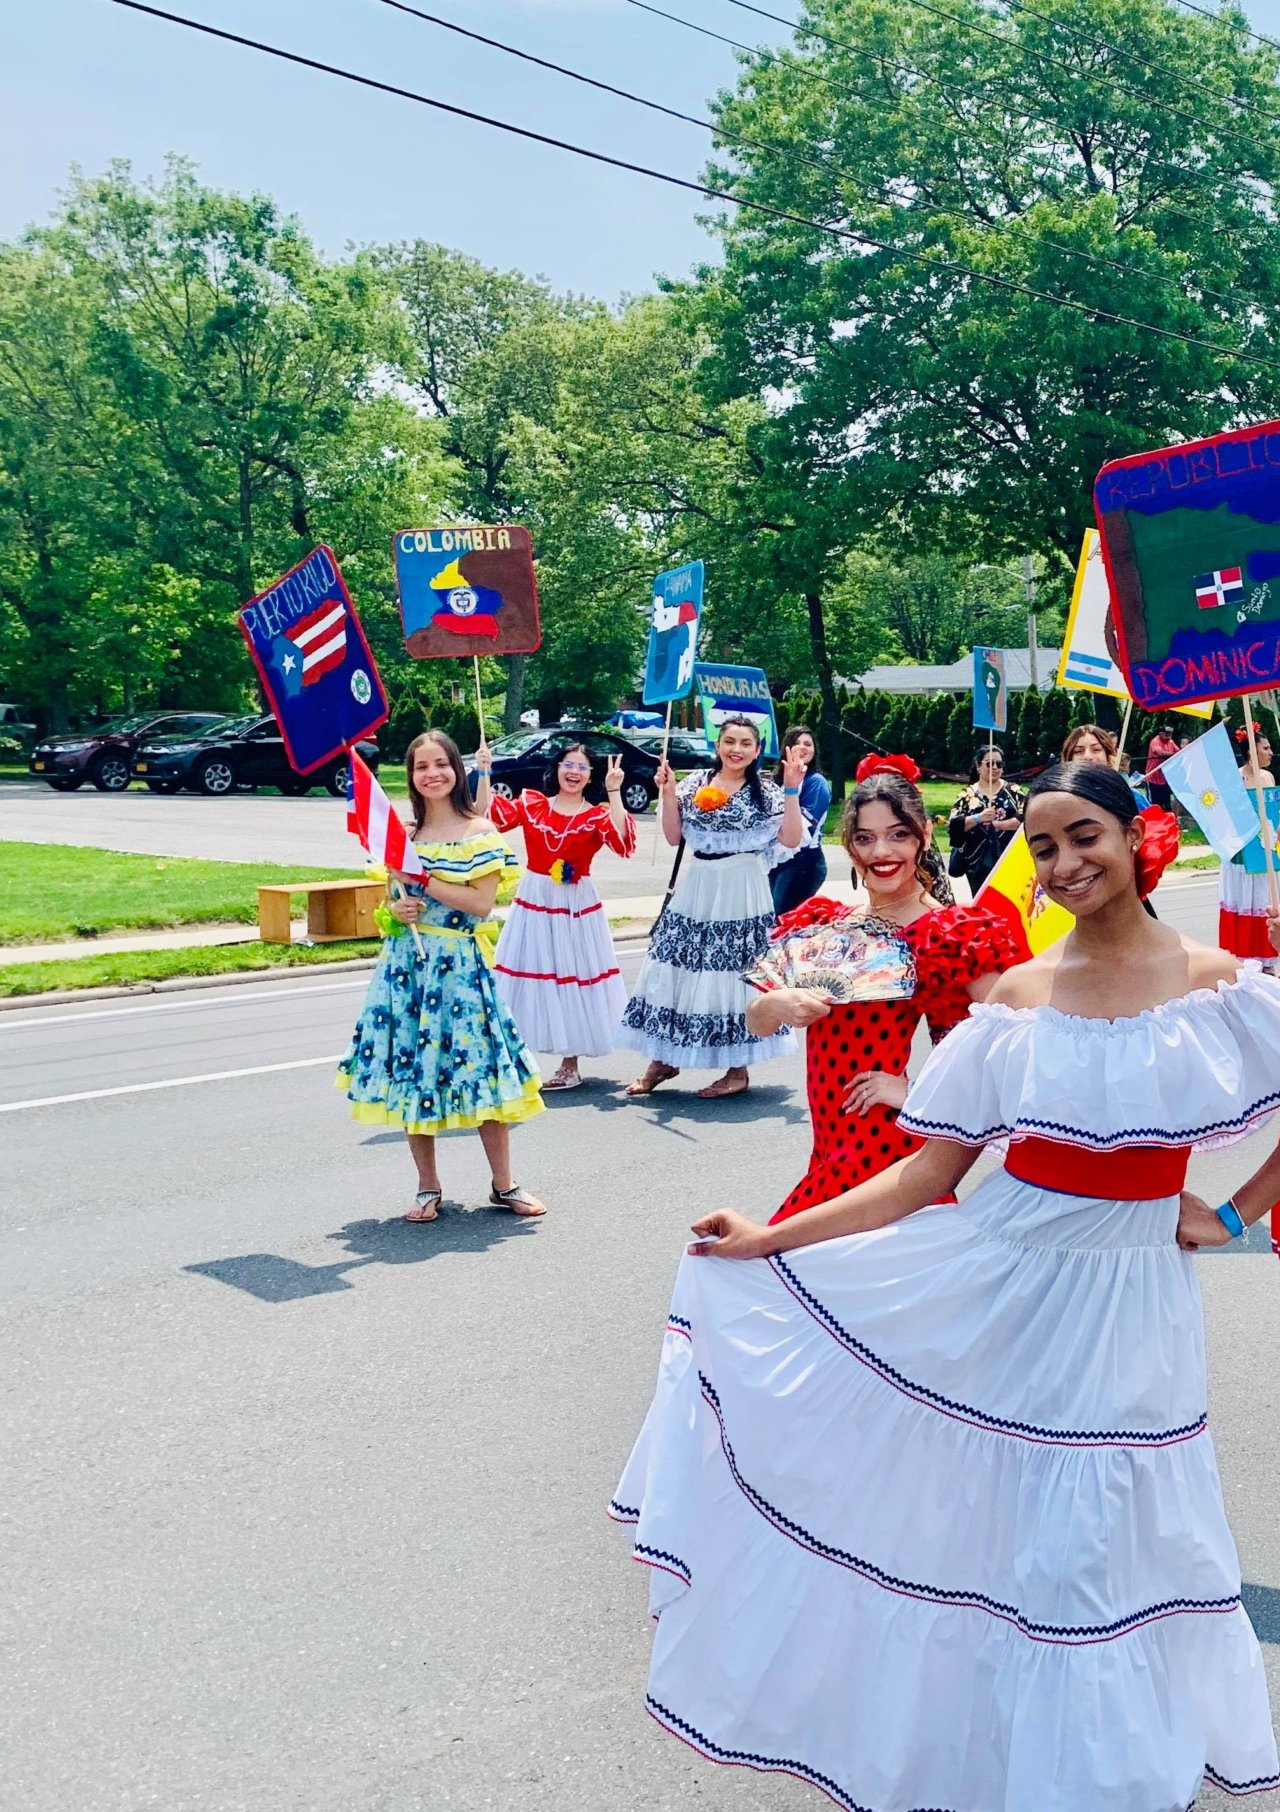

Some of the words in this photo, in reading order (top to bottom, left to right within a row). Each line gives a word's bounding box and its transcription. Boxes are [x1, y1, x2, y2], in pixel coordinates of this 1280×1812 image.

[400, 529, 511, 553] COLOMBIA
[240, 577, 304, 645] PUERTO
[696, 672, 771, 700] HONDURAS
